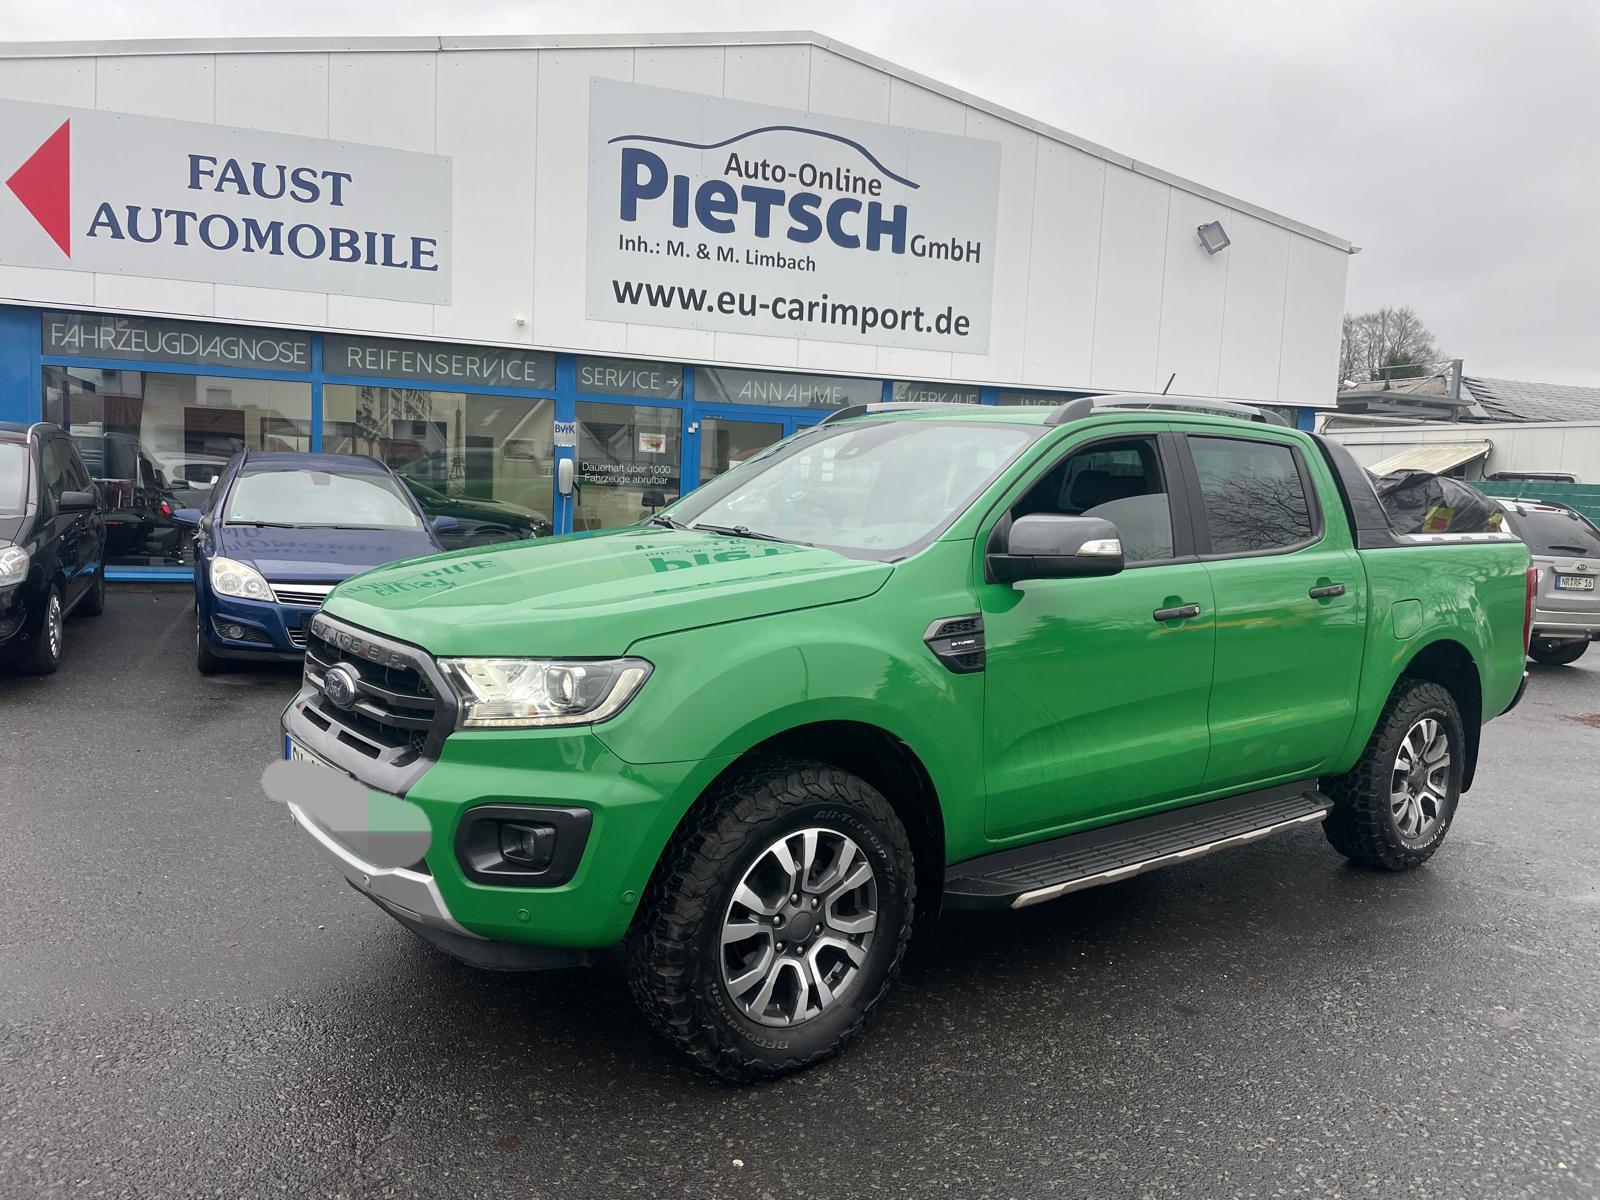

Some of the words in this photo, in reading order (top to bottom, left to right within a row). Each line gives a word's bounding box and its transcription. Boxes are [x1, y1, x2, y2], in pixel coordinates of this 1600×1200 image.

[188, 153, 352, 206] FAUST
[724, 152, 882, 197] Auto-Online
[86, 202, 439, 272] AUTOMOBILE
[618, 234, 661, 255] Inh.:
[666, 240, 691, 258] M.
[696, 244, 711, 260] &
[716, 247, 740, 264] M.
[745, 249, 816, 272] Limbach
[910, 235, 982, 264] GmbH
[612, 279, 970, 336] www.eu-carimport.de
[51, 323, 307, 365] FAHRZEUGDIAGNOSE
[347, 346, 536, 382] REIFENSERVICE
[581, 366, 661, 390] SERVICE
[738, 380, 842, 405] ANNAHME
[582, 462, 625, 473] Dauerhaft
[626, 464, 647, 474] über
[649, 465, 671, 475] 1000
[584, 473, 631, 486] Fahrzeuge
[632, 475, 669, 485] abrufbar
